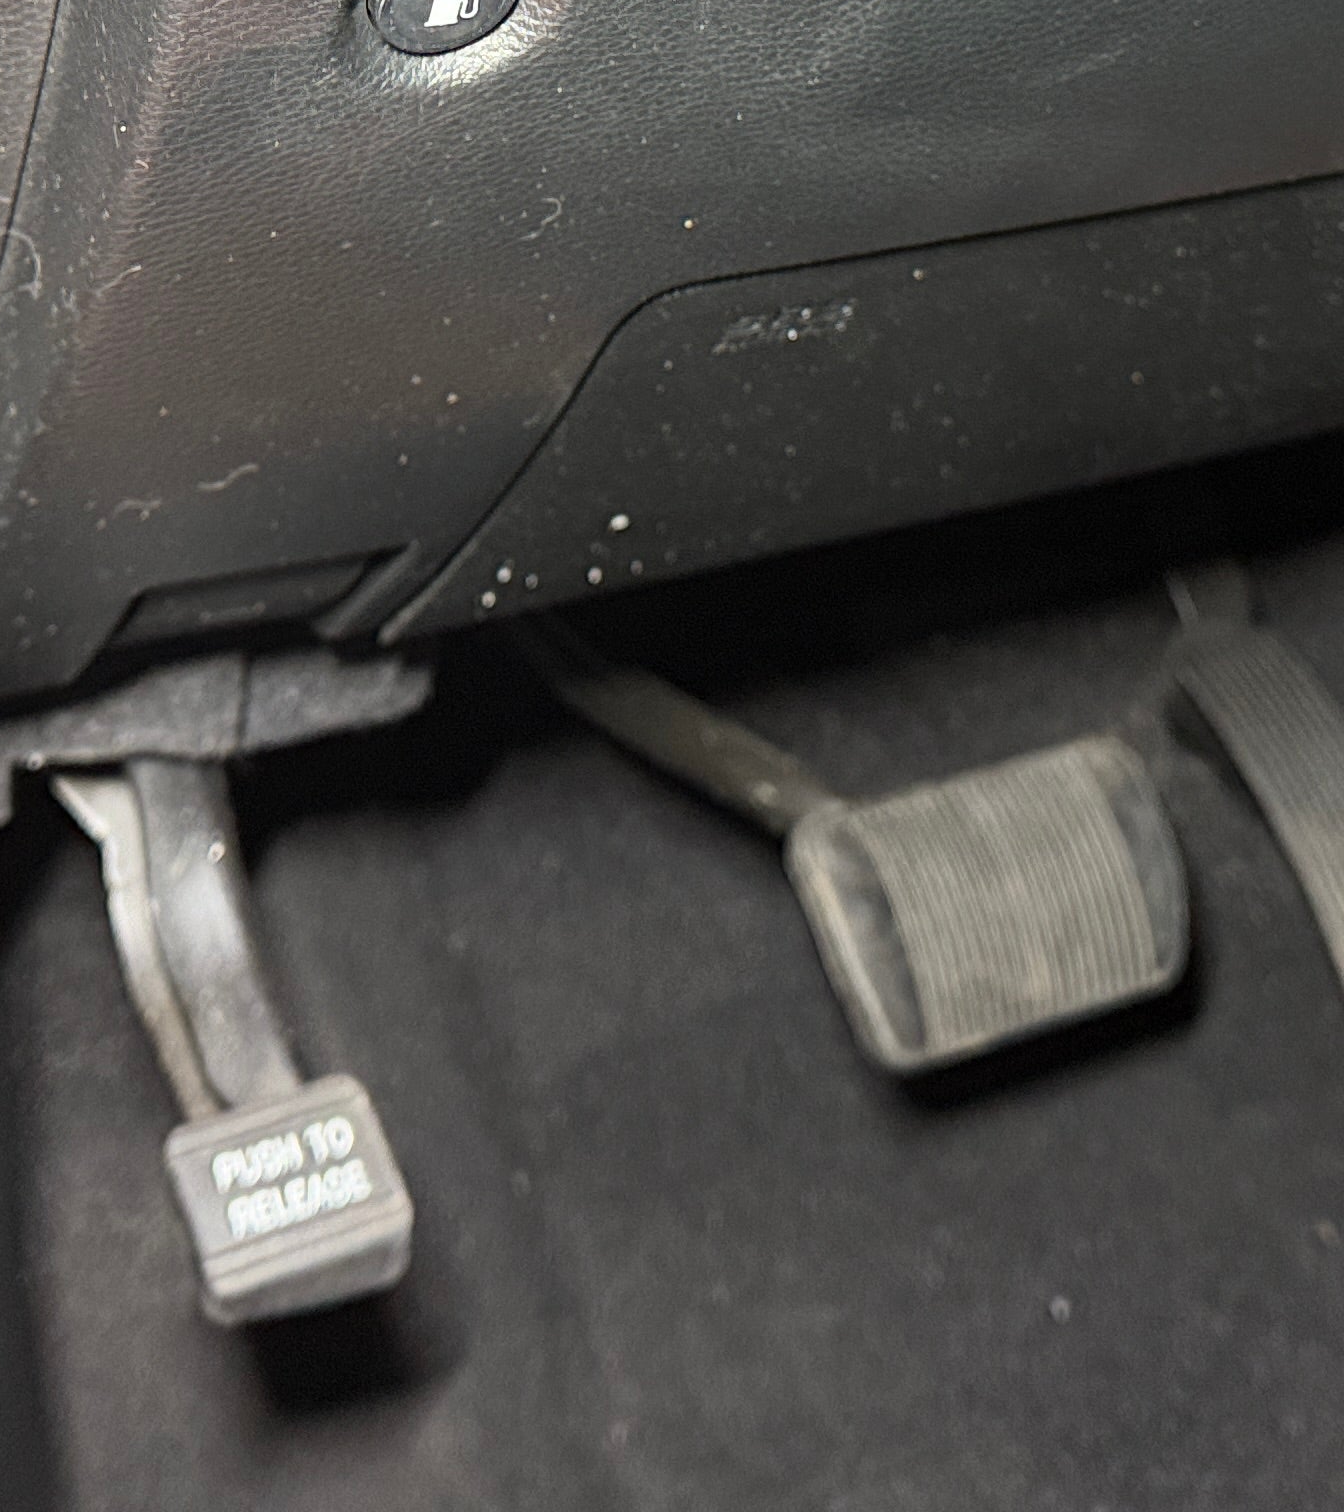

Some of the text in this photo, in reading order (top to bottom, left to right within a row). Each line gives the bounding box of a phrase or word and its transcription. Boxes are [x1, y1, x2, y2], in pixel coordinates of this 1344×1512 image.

[212, 1115, 355, 1194] PUSH TO
[227, 1157, 373, 1240] RELEASE
